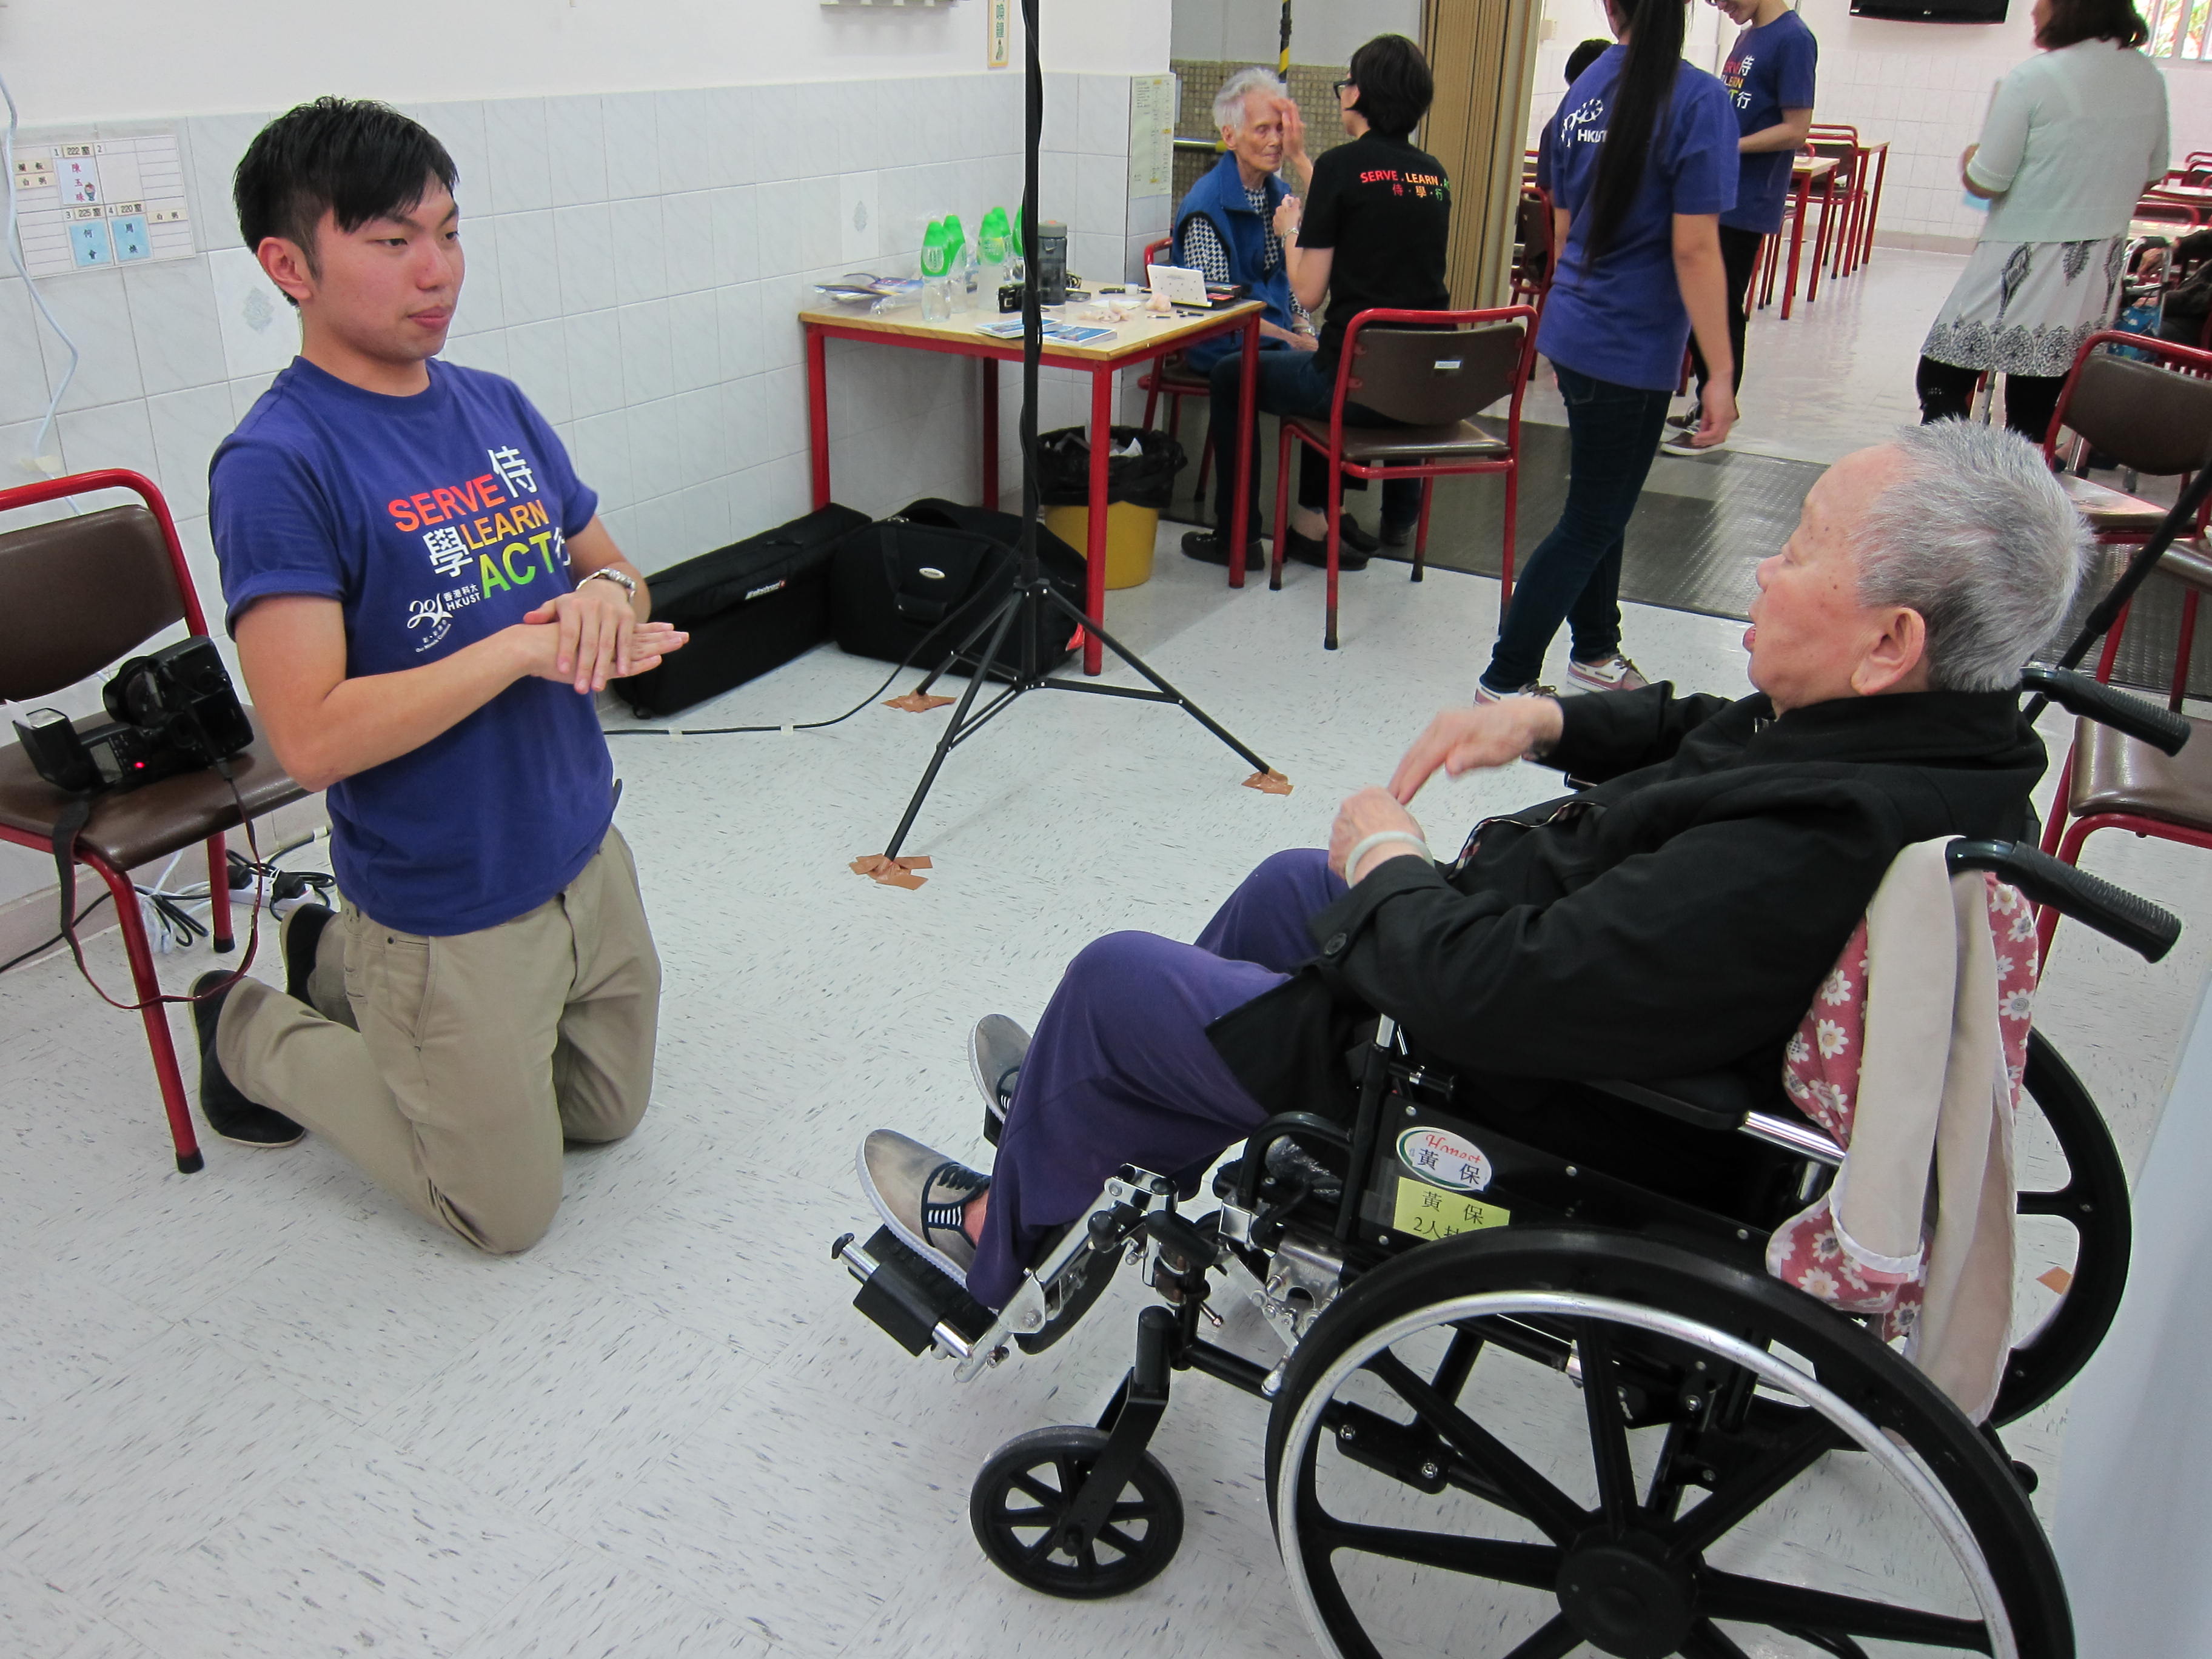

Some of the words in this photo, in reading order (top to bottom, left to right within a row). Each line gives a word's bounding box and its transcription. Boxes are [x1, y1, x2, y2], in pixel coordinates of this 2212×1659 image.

[1736, 91, 1752, 109] 行
[53, 148, 59, 156] 1
[1359, 169, 1399, 183] SERVE
[1405, 172, 1439, 186] LEARN
[487, 445, 538, 498] 侍
[387, 474, 506, 532] SERVE
[460, 500, 550, 550] LEARN
[422, 526, 474, 577] 學
[477, 531, 555, 599] ACT
[446, 592, 481, 611] HKUST
